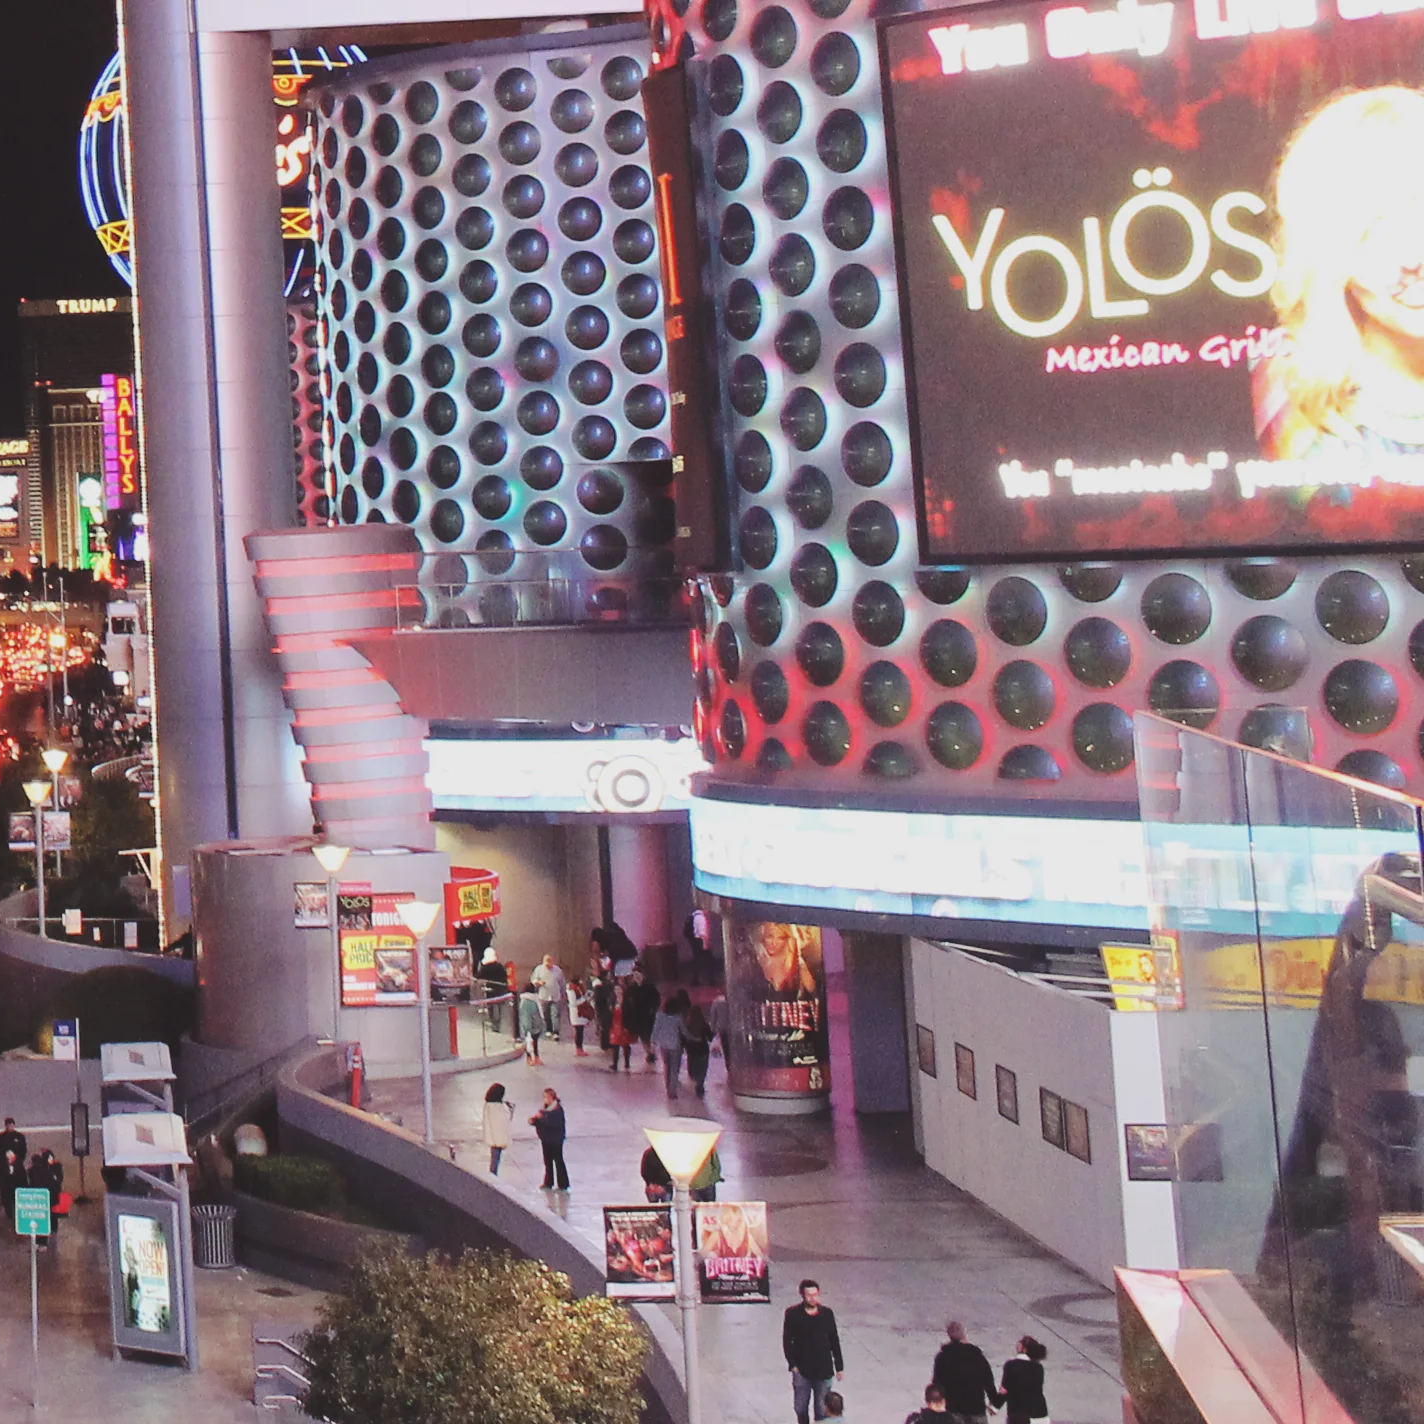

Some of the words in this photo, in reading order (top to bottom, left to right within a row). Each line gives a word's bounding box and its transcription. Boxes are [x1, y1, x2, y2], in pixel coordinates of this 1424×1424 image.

[56, 298, 118, 314] TRUMP
[1045, 333, 1190, 373] Mexican
[139, 1239, 164, 1258] NOW
